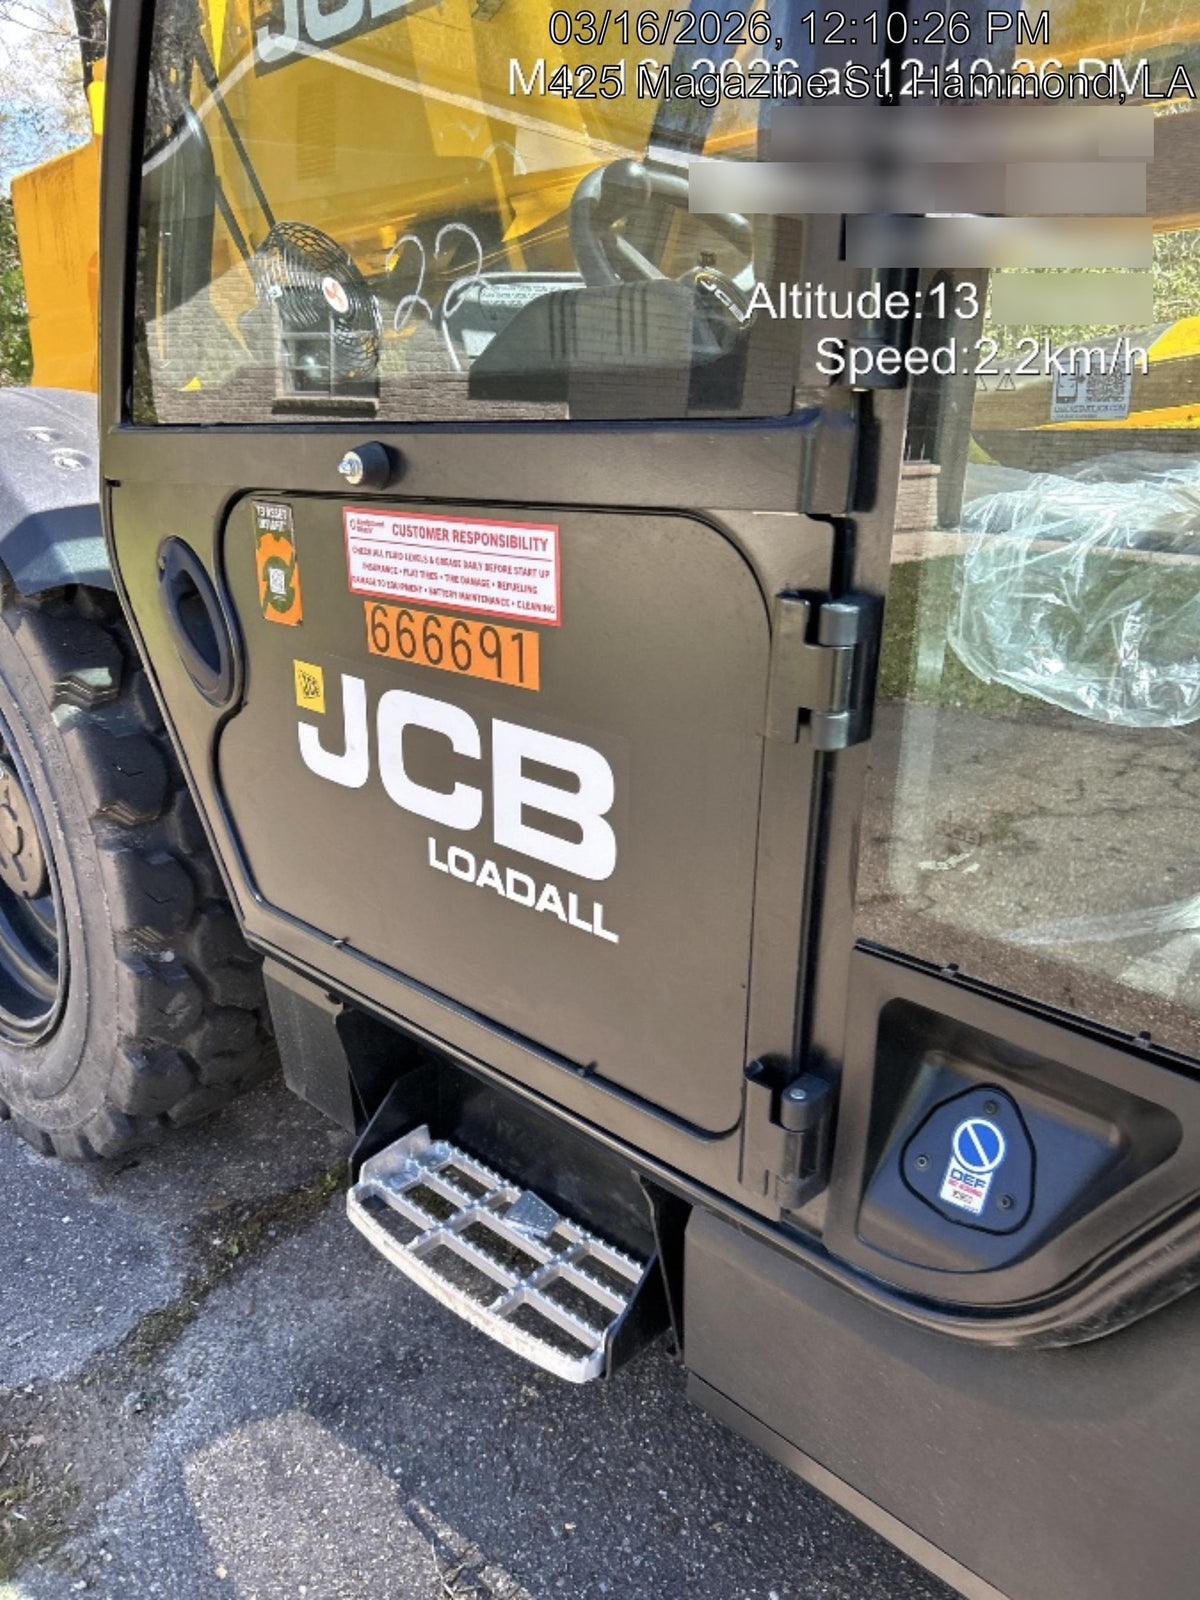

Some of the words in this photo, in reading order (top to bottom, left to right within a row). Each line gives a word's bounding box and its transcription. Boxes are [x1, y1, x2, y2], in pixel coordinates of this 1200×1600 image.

[392, 523, 450, 542] CUSTOMER
[453, 529, 549, 552] RESPONSIBILITY
[513, 566, 537, 578] START
[539, 569, 550, 579] UP
[371, 604, 525, 683] 666691
[298, 674, 617, 881] JCB
[428, 837, 619, 943] LOADALL
[950, 1168, 986, 1188] DEF
